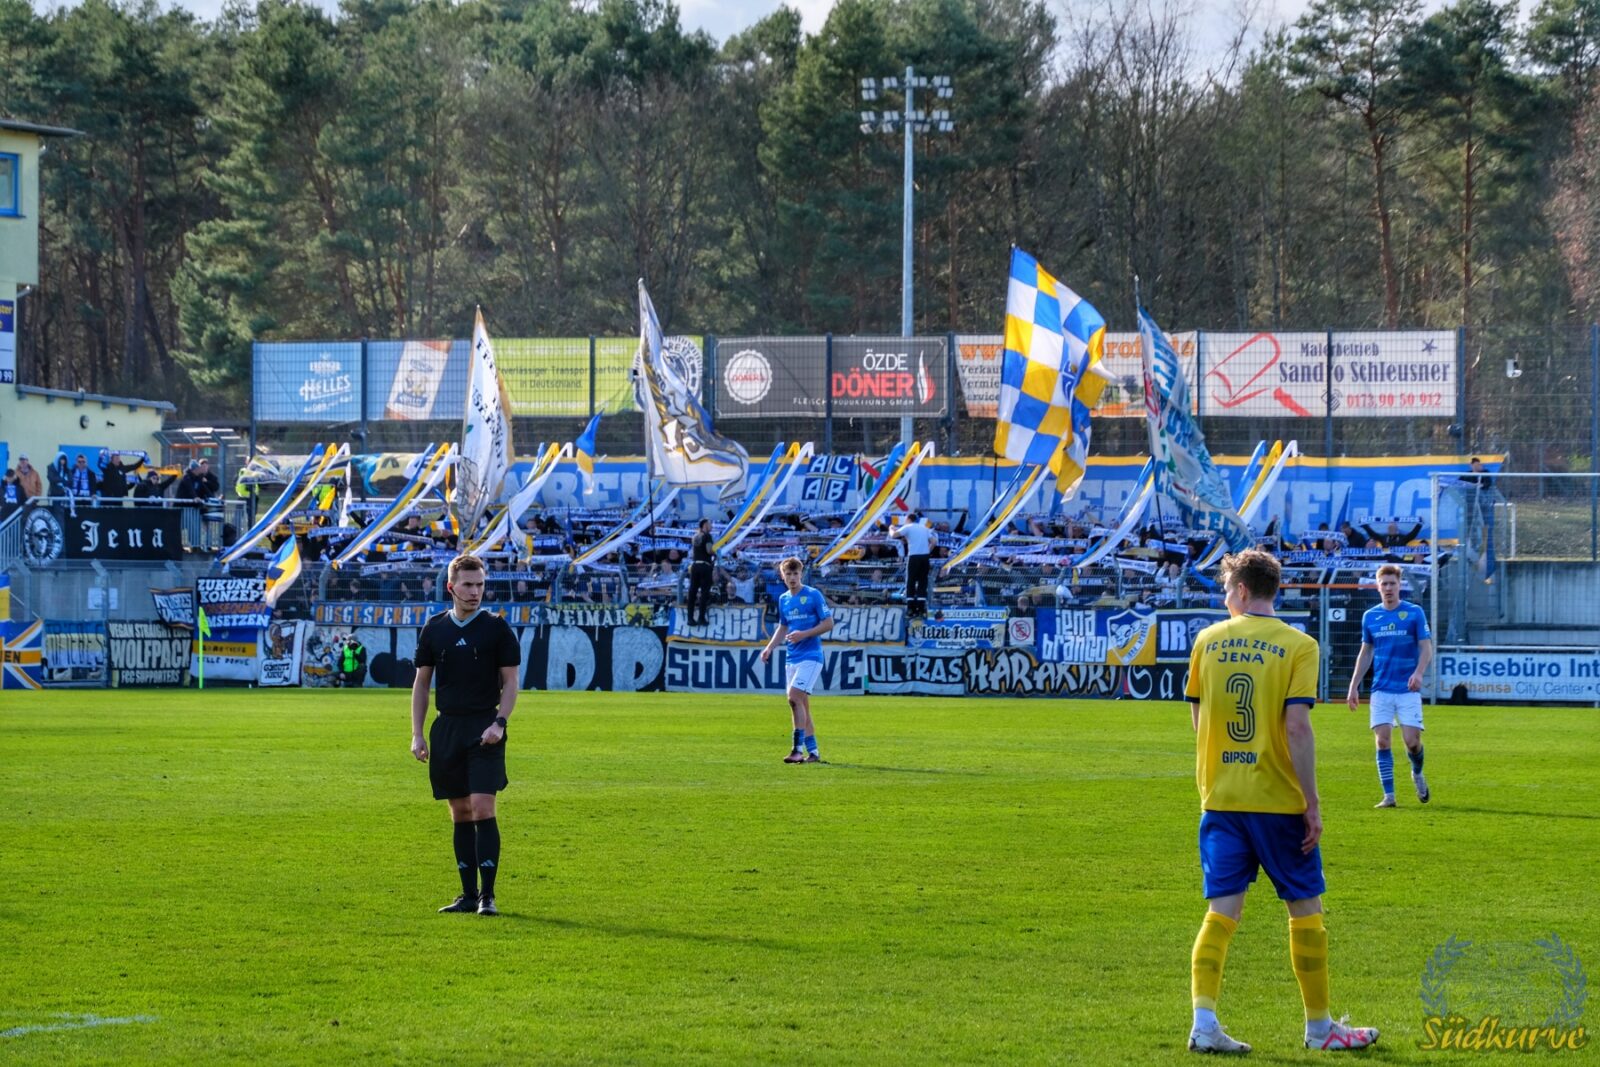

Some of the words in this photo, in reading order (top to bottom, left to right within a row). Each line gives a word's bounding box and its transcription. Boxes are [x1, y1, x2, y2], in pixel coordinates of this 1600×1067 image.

[863, 348, 908, 371] ÖZDE
[1351, 361, 1450, 383] Schleusner
[832, 368, 914, 398] DÖNER
[80, 519, 165, 552] Jena
[197, 578, 266, 591] ZUKUNFT
[206, 613, 271, 628] MSETZEN
[546, 607, 629, 626] WEIMAR
[1332, 609, 1341, 620] C
[109, 638, 192, 670] WOLFPACK
[1205, 641, 1219, 655] FC
[1221, 638, 1249, 649] CARL
[1252, 639, 1287, 659] ZEISS
[1218, 651, 1265, 665] JENA
[667, 646, 863, 690] SÜDKUVE
[868, 653, 962, 683] ULTRAS
[1441, 656, 1562, 677] Reisebüro
[1515, 682, 1541, 697] City
[1543, 682, 1586, 695] Center
[1226, 672, 1256, 743] 3
[1222, 750, 1258, 765] GIPSON
